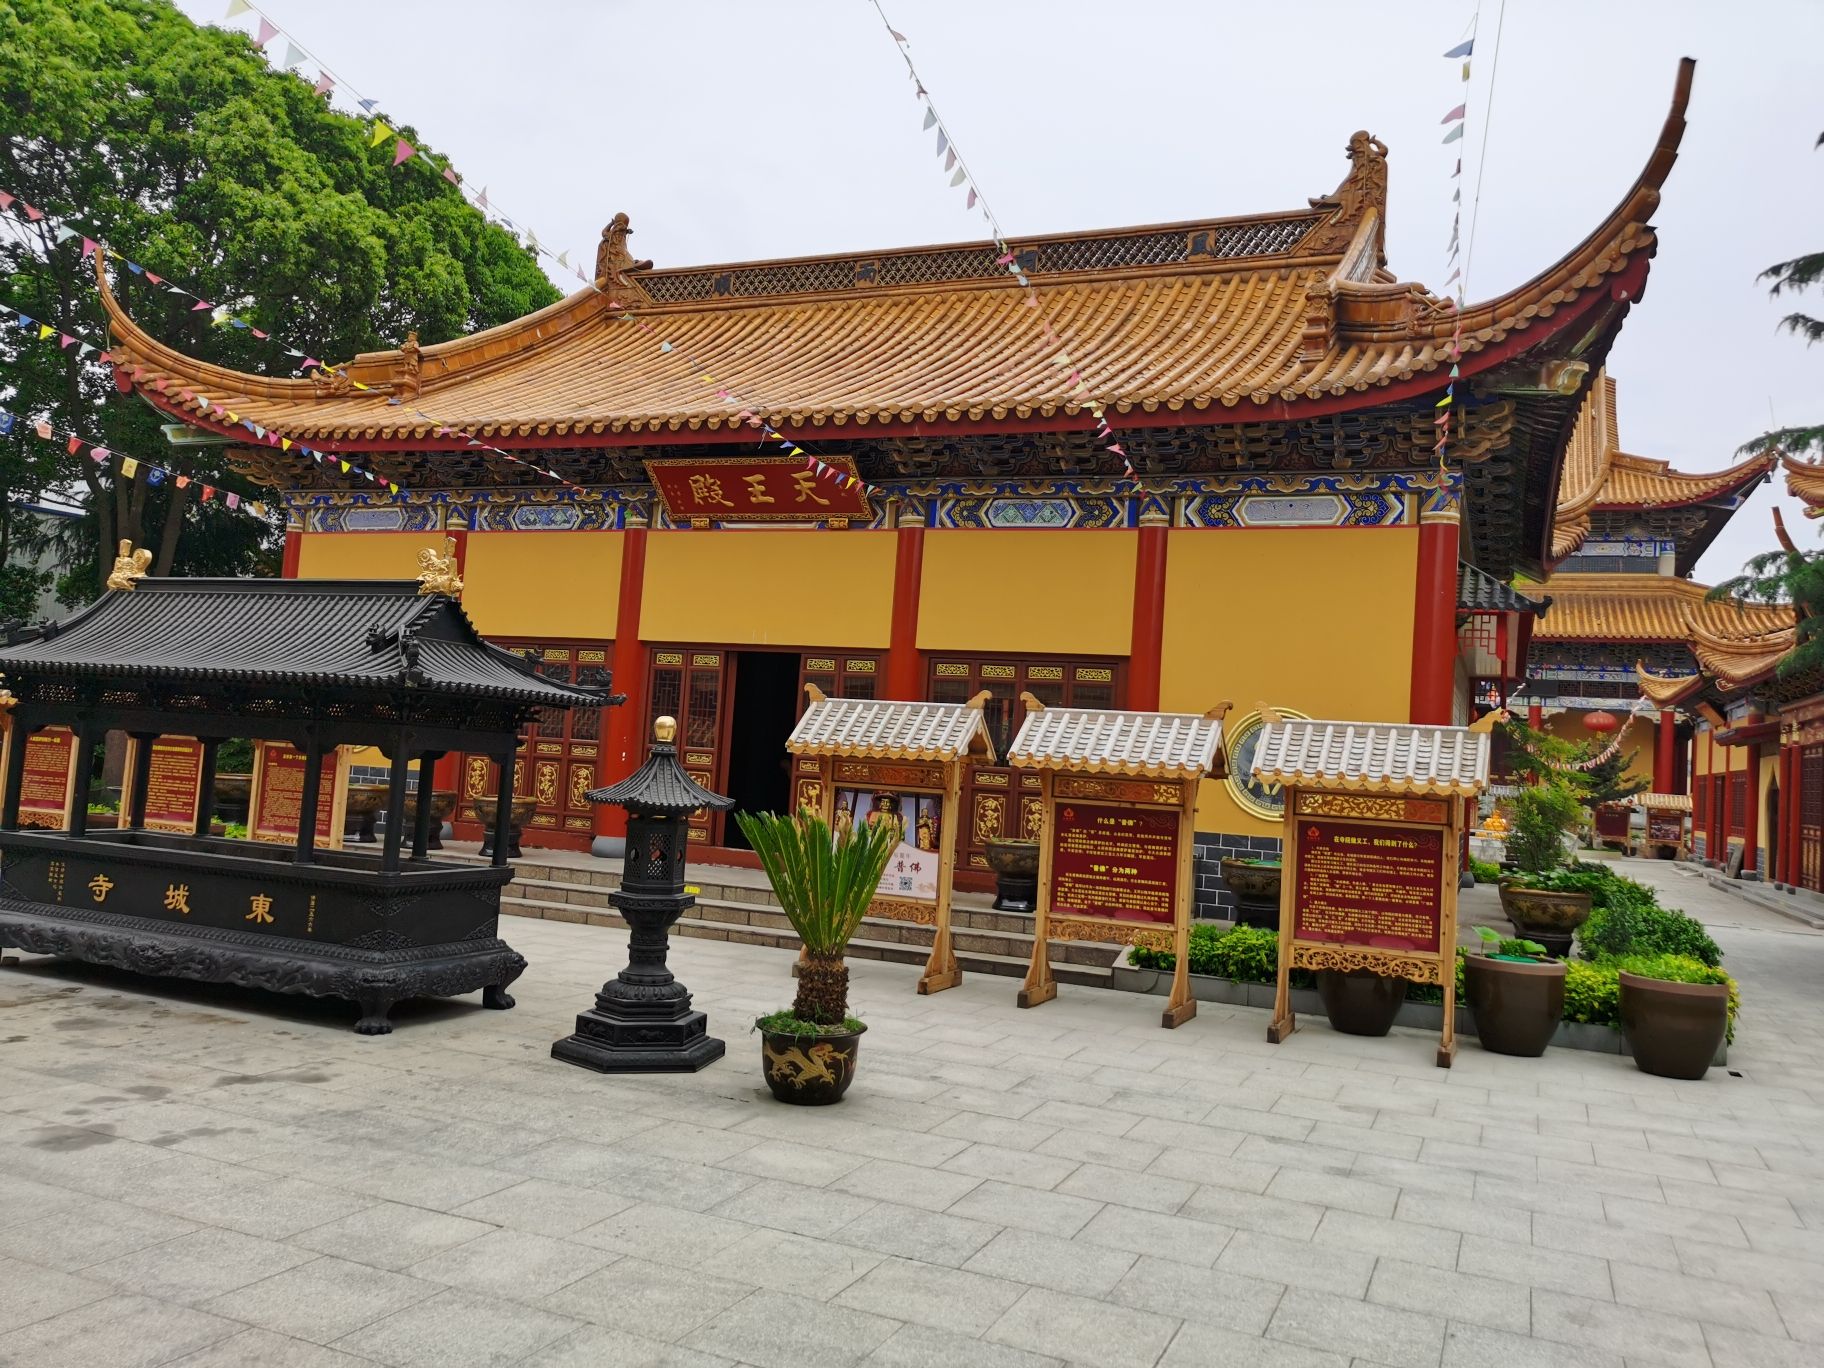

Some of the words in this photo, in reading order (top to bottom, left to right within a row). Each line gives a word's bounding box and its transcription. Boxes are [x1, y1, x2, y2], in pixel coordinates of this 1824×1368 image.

[688, 470, 831, 508] 天王殿
[88, 872, 275, 925] 東城寺
